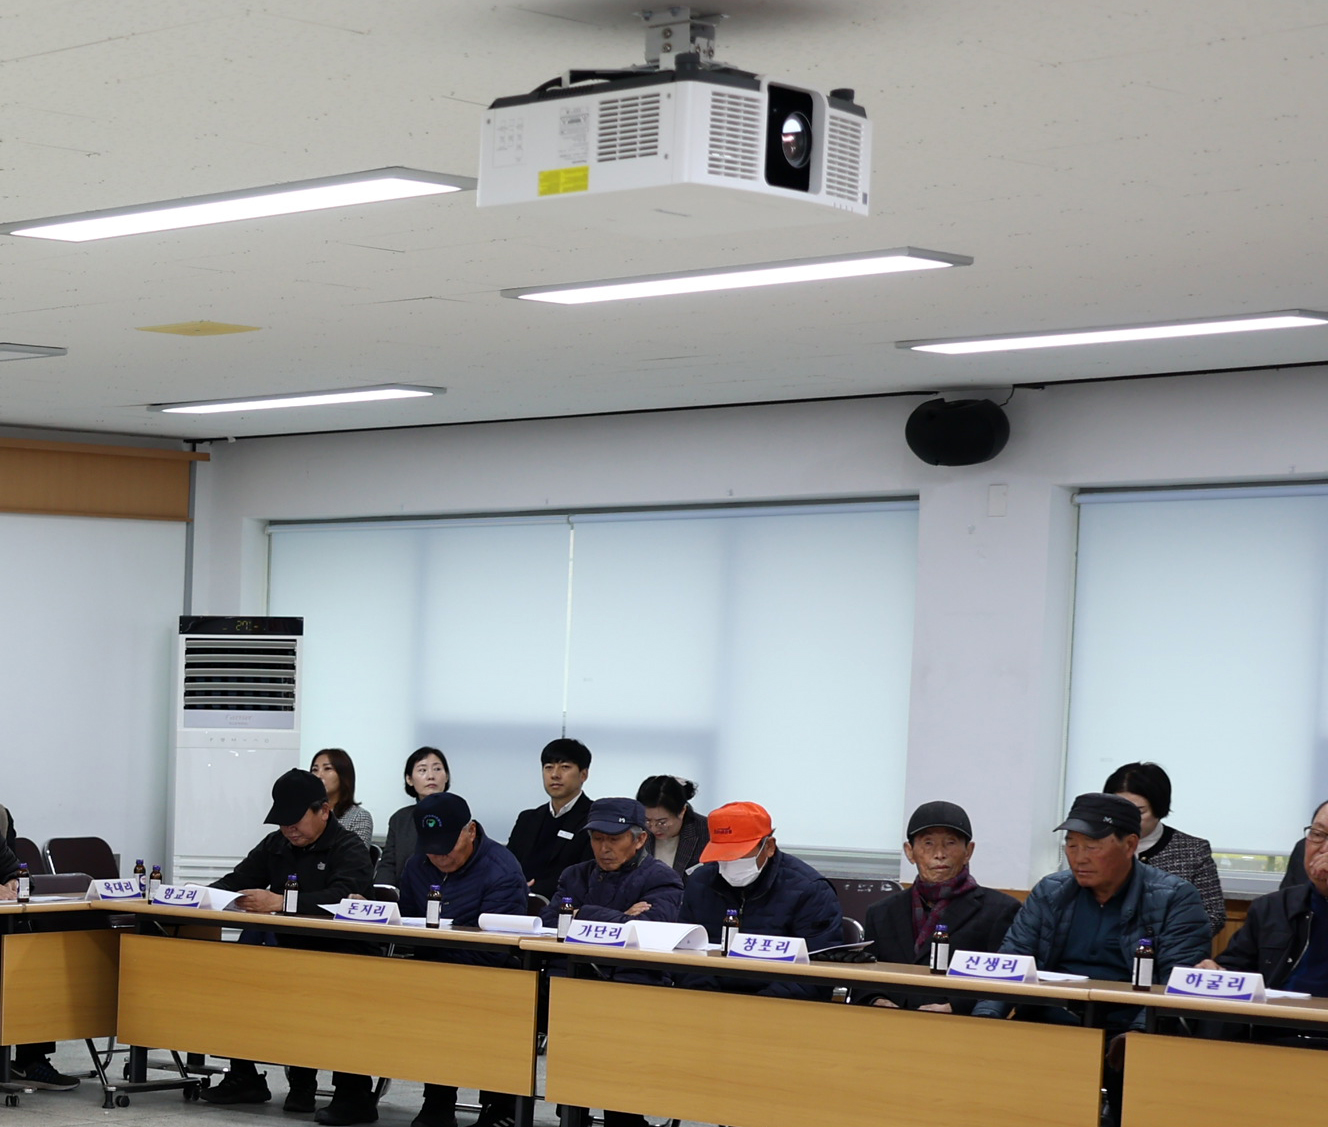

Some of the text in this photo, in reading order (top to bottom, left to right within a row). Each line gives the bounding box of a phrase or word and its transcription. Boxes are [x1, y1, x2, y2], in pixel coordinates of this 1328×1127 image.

[104, 882, 134, 893] 옥대리
[164, 887, 197, 901] 향교리
[348, 902, 385, 917] 돈지리
[578, 924, 621, 940] 가단리
[743, 937, 790, 954] 창포리
[965, 956, 1018, 973] 신생리
[1186, 973, 1246, 992] 하굴리
